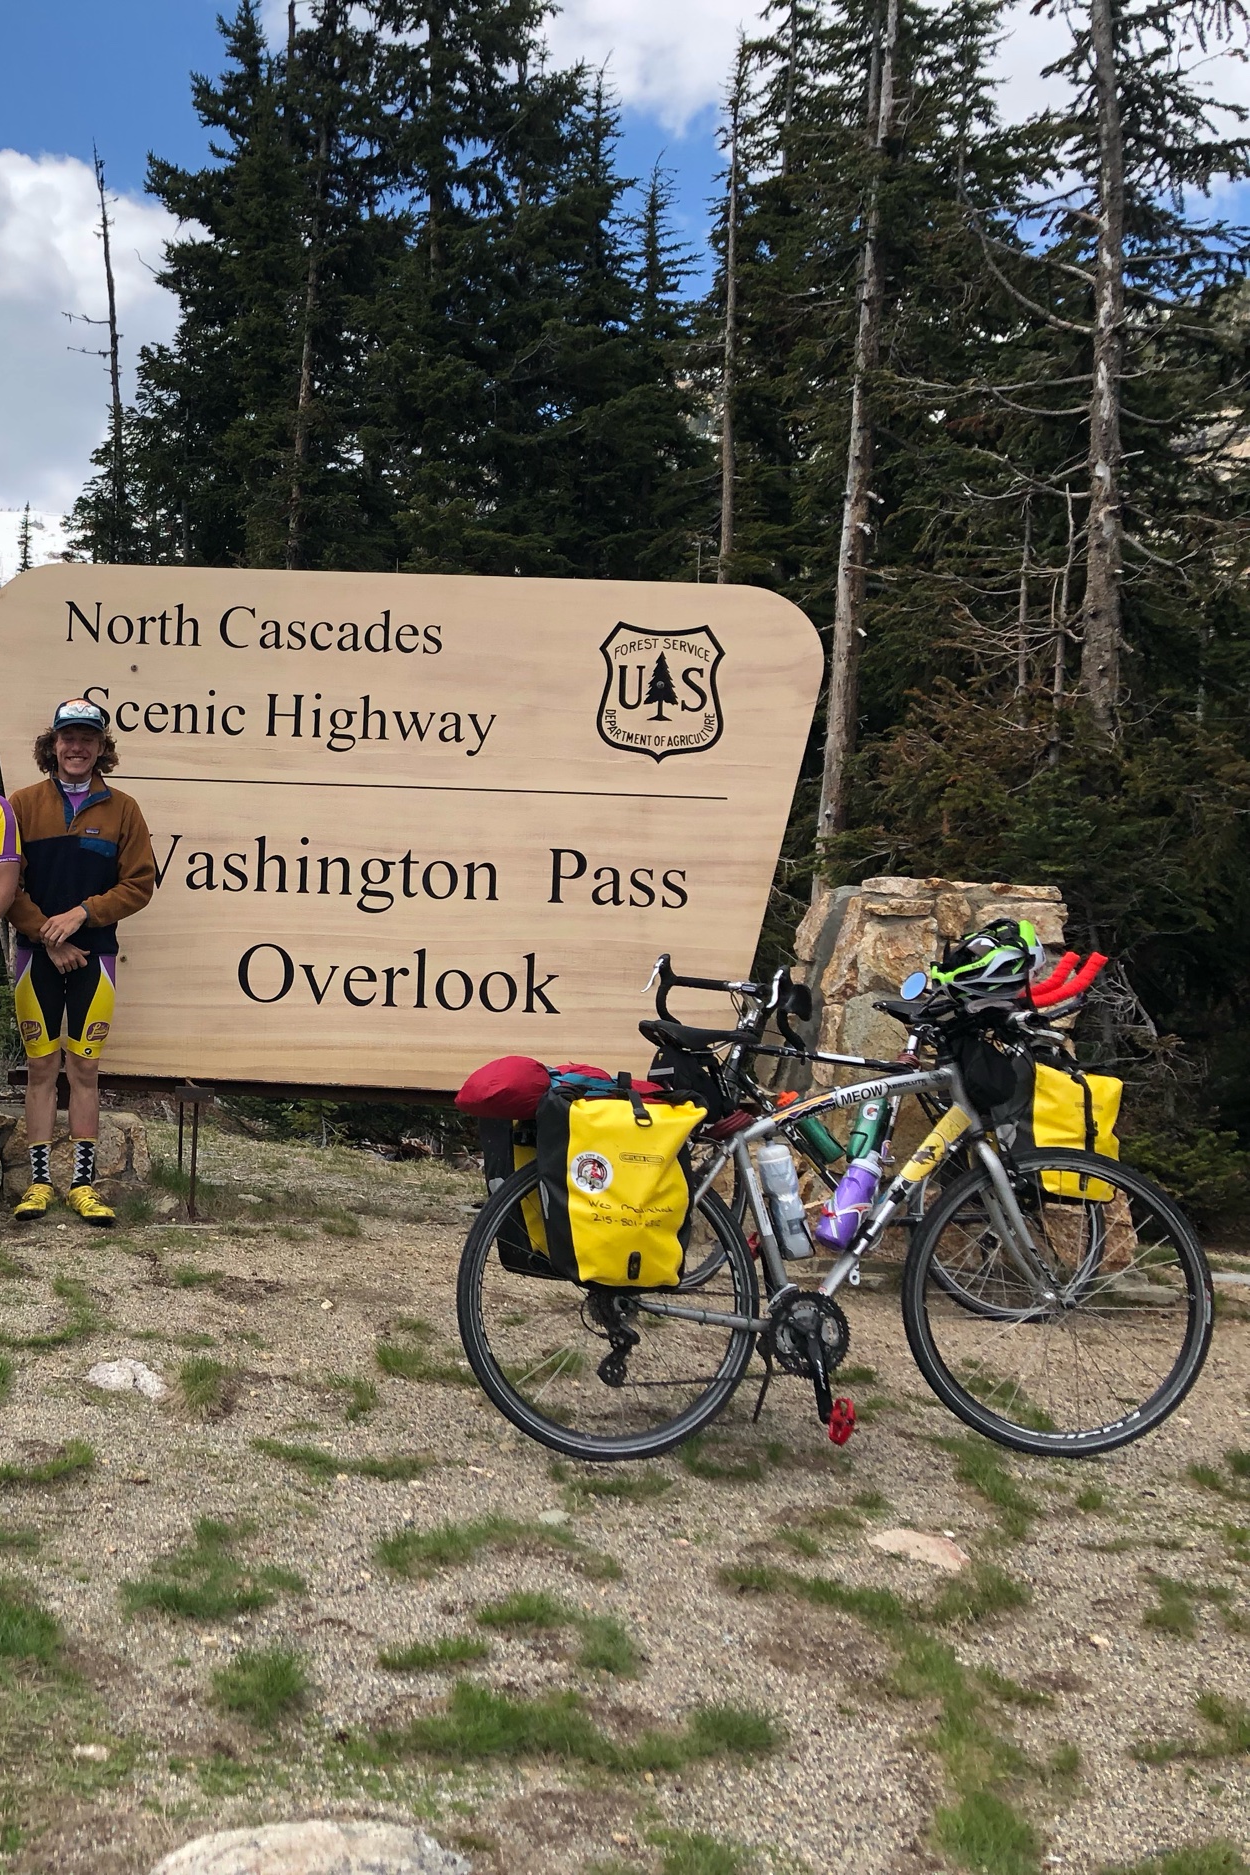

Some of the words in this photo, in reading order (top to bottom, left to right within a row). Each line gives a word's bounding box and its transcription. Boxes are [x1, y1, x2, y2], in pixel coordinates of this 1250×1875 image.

[65, 600, 202, 647] North
[220, 606, 443, 655] Cascades
[614, 638, 659, 660] FOREST
[662, 638, 711, 662] SERVICE
[618, 664, 646, 710] U
[680, 666, 708, 713] S
[82, 686, 246, 738] Scenic
[265, 693, 497, 757] Highway
[604, 709, 652, 747] DEPARTMENT
[653, 735, 667, 747] OF
[667, 712, 716, 748] AGRICULTURE
[547, 848, 688, 909] Pass
[237, 943, 561, 1015] Overlook
[840, 1084, 884, 1106] MEOW
